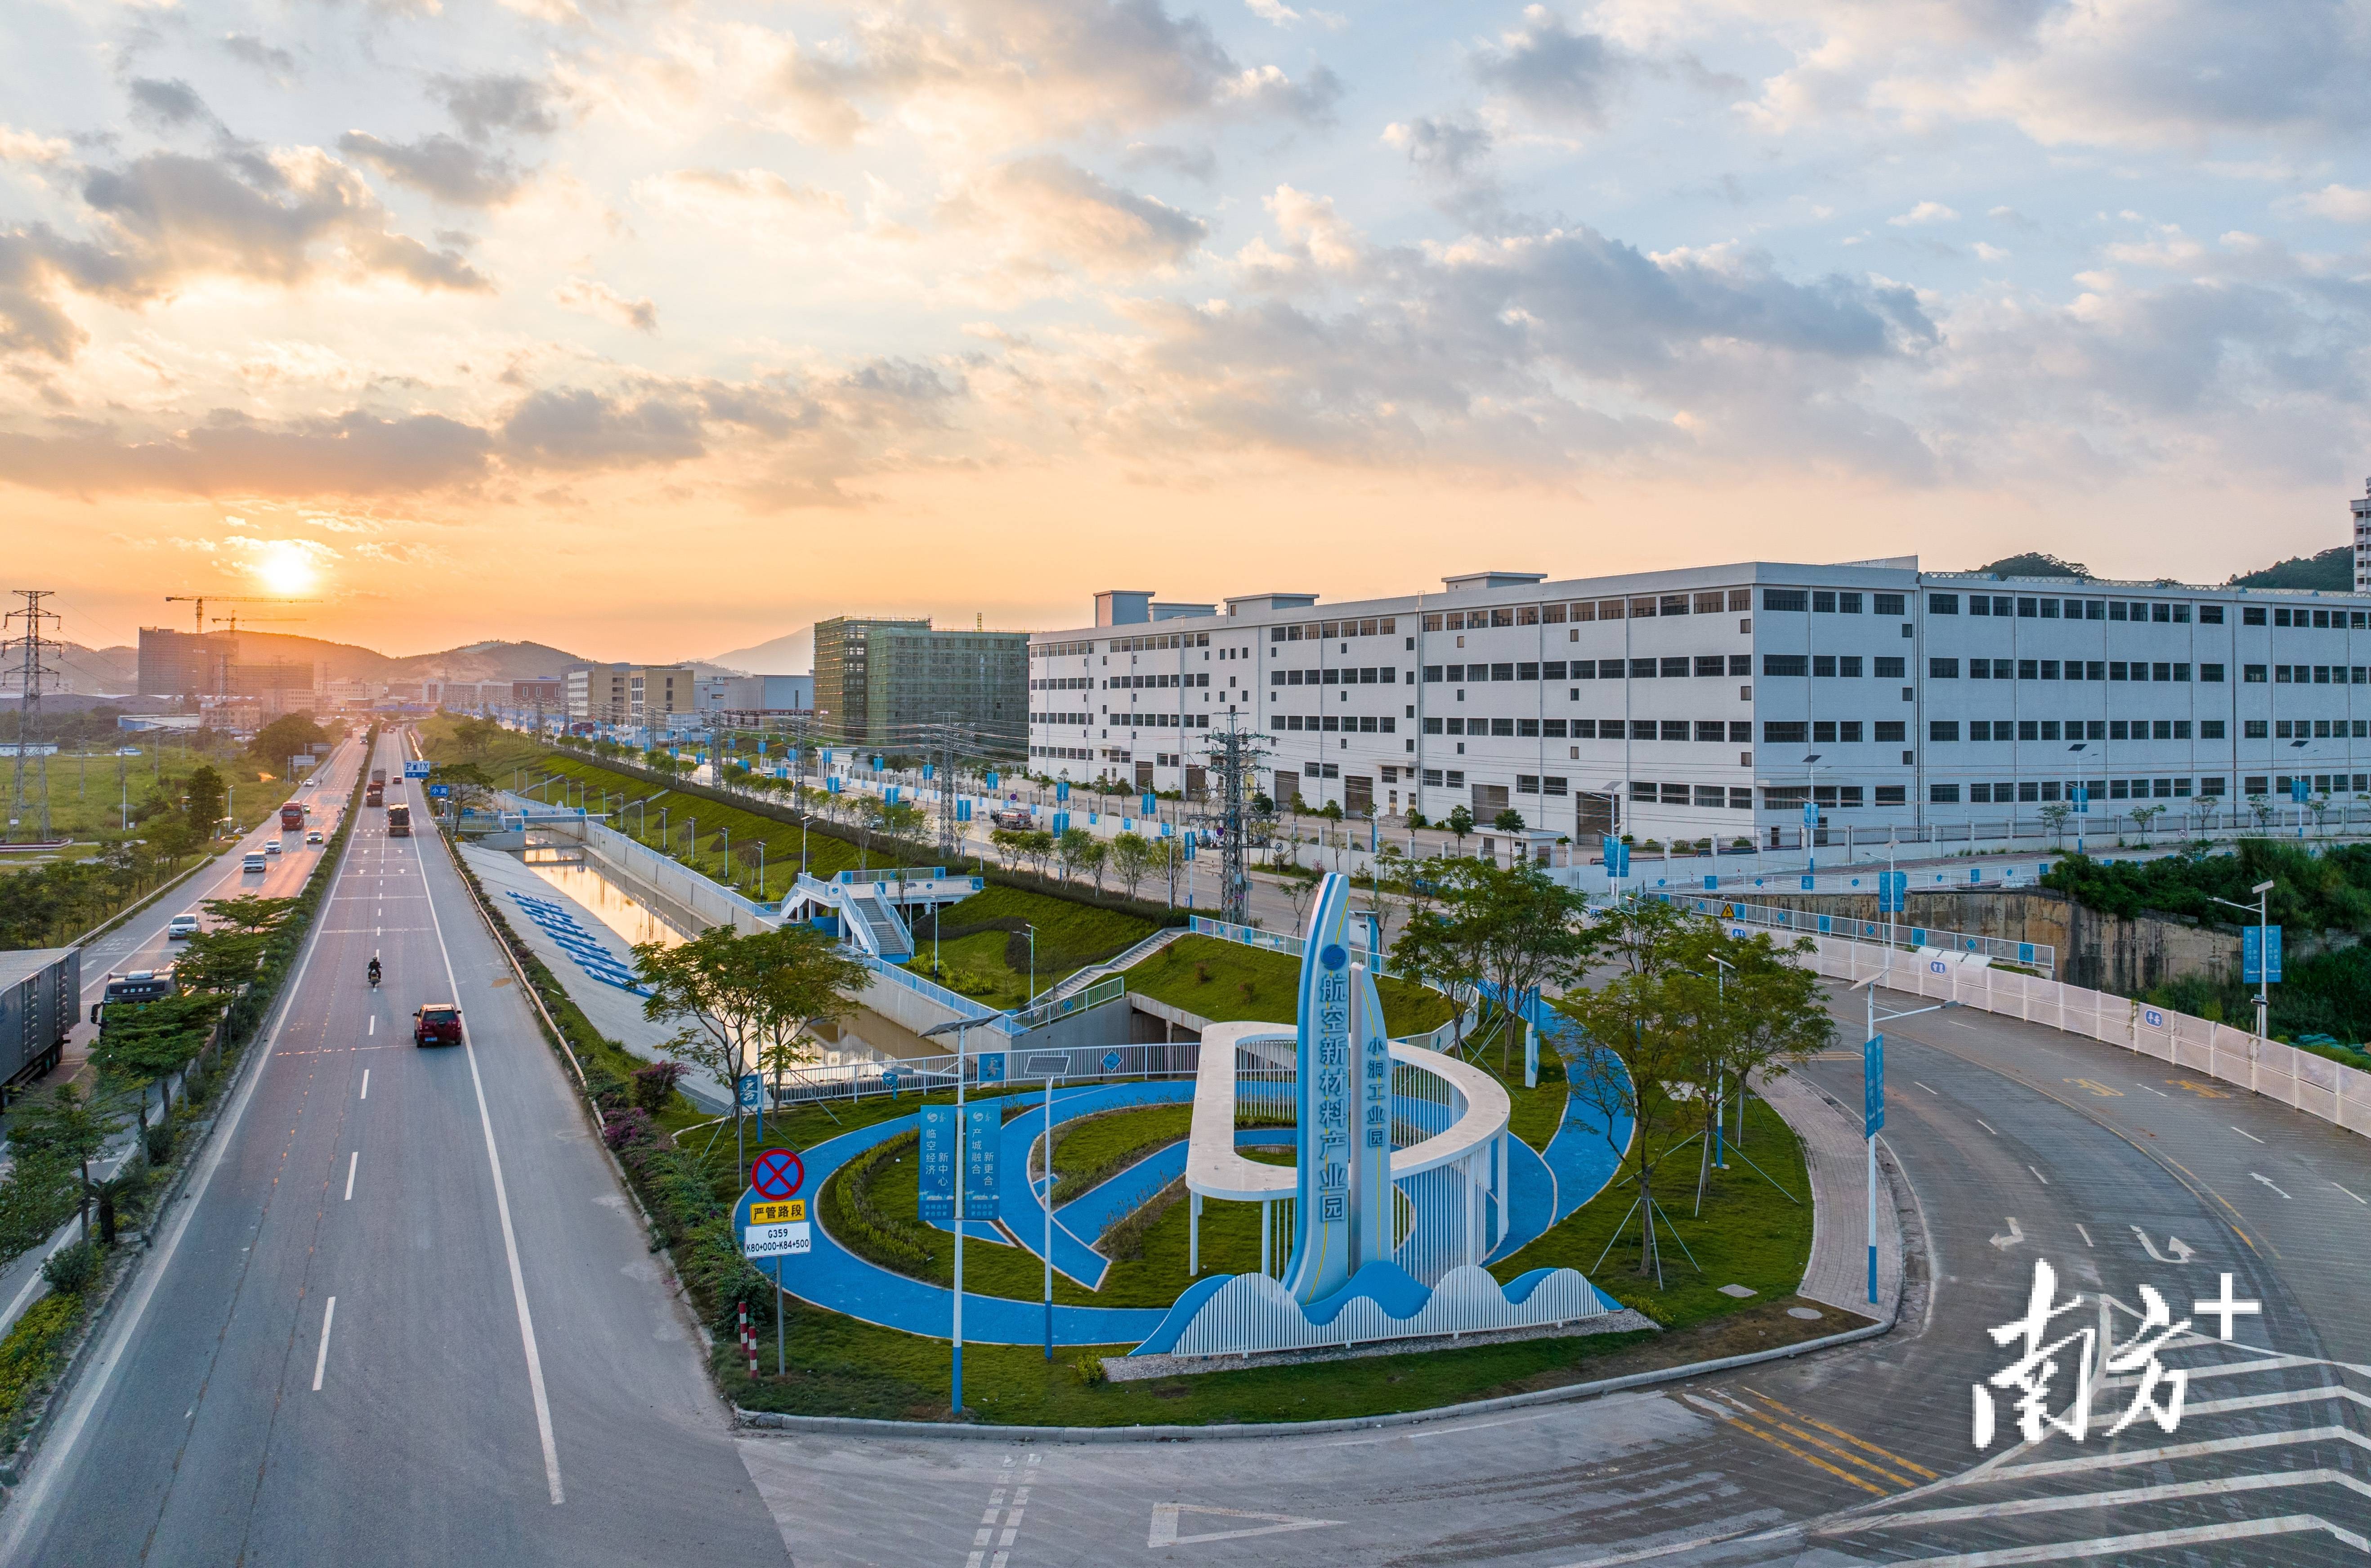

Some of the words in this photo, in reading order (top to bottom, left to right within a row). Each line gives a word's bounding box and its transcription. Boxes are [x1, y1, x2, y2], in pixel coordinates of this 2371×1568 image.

[1320, 974, 1347, 1223] 航空新材料产业园
[1367, 1036, 1386, 1148] 小洞工业园
[926, 1128, 936, 1175] 临空经济
[971, 1128, 982, 1175] 产城融合
[984, 1151, 994, 1186] 新更合
[938, 1152, 948, 1187] 新中心
[754, 1204, 802, 1220] 严管路段
[747, 1239, 809, 1253] K80+000-K84+500
[768, 1228, 788, 1238] G359
